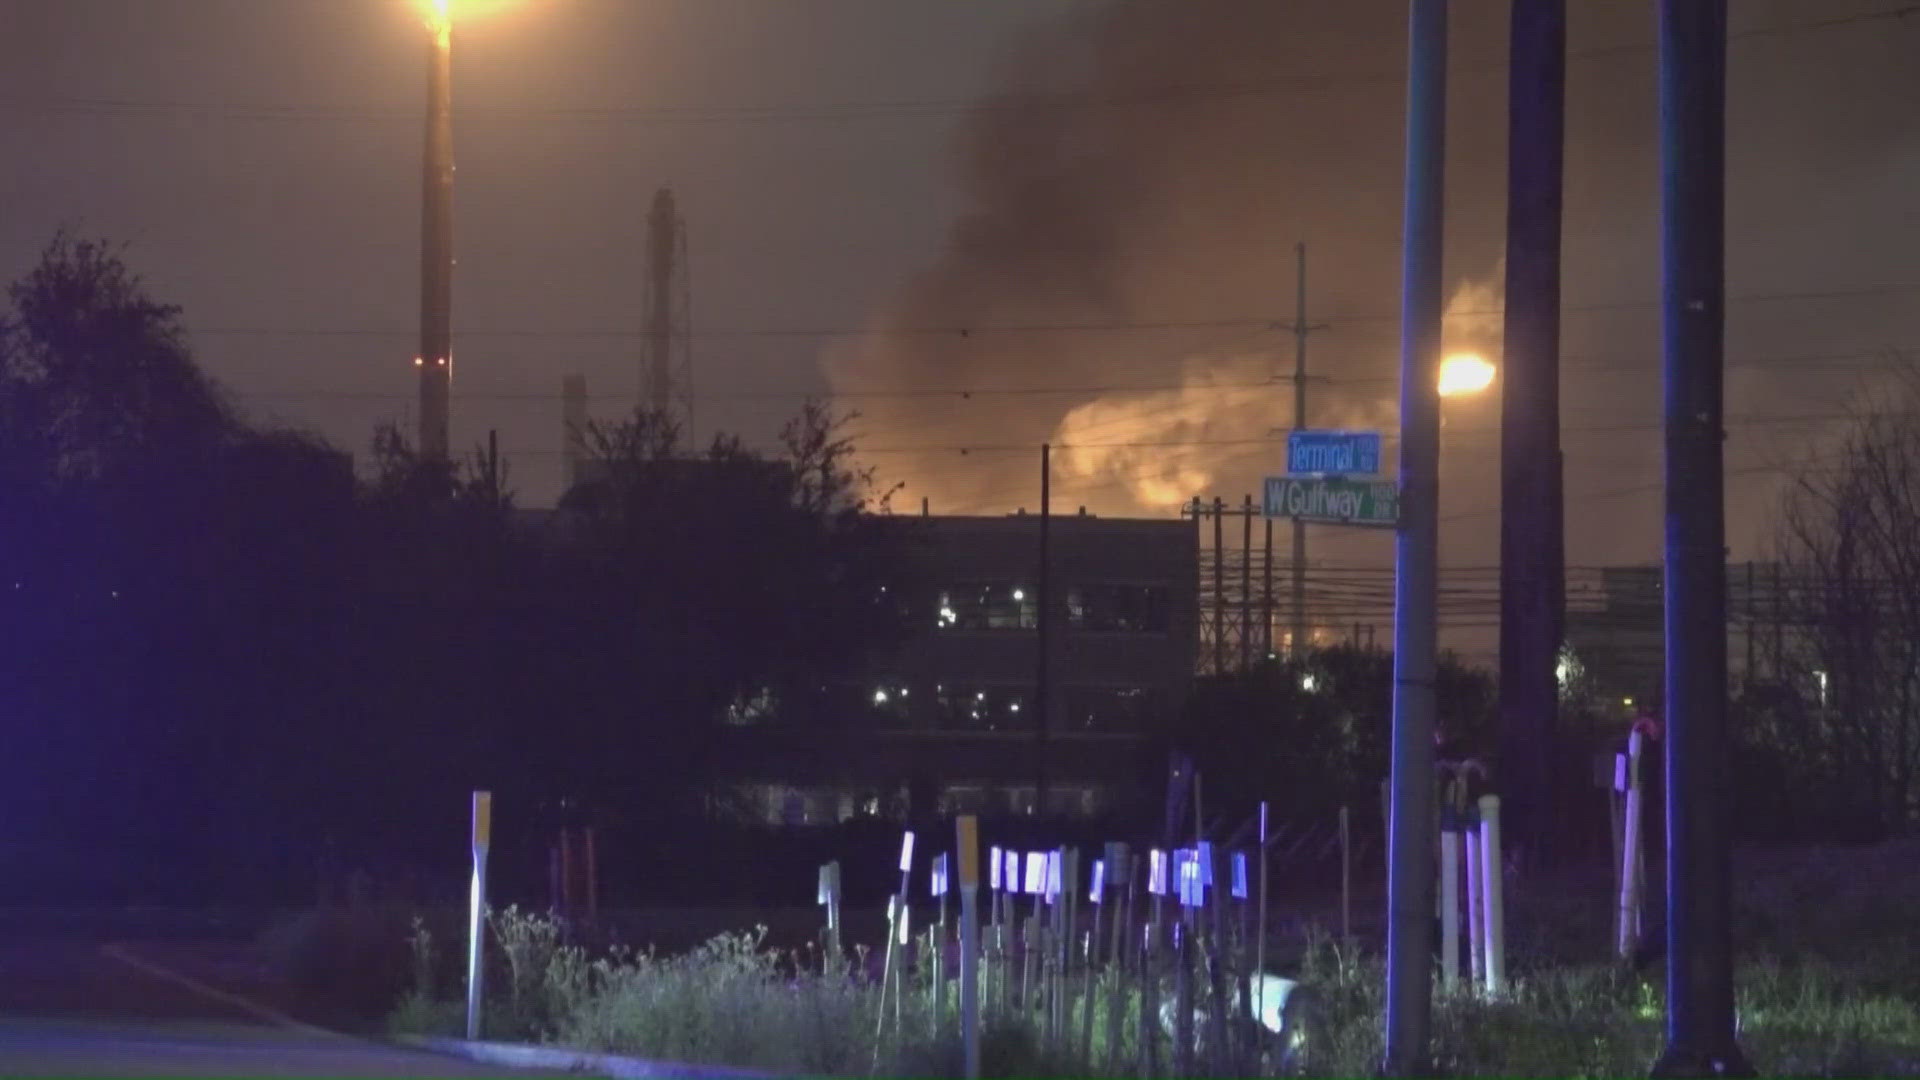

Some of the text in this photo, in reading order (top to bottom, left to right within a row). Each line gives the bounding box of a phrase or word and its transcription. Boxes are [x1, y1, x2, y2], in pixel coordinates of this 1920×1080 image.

[1290, 437, 1354, 470] Terminal
[1268, 481, 1364, 518] W Gulfway
